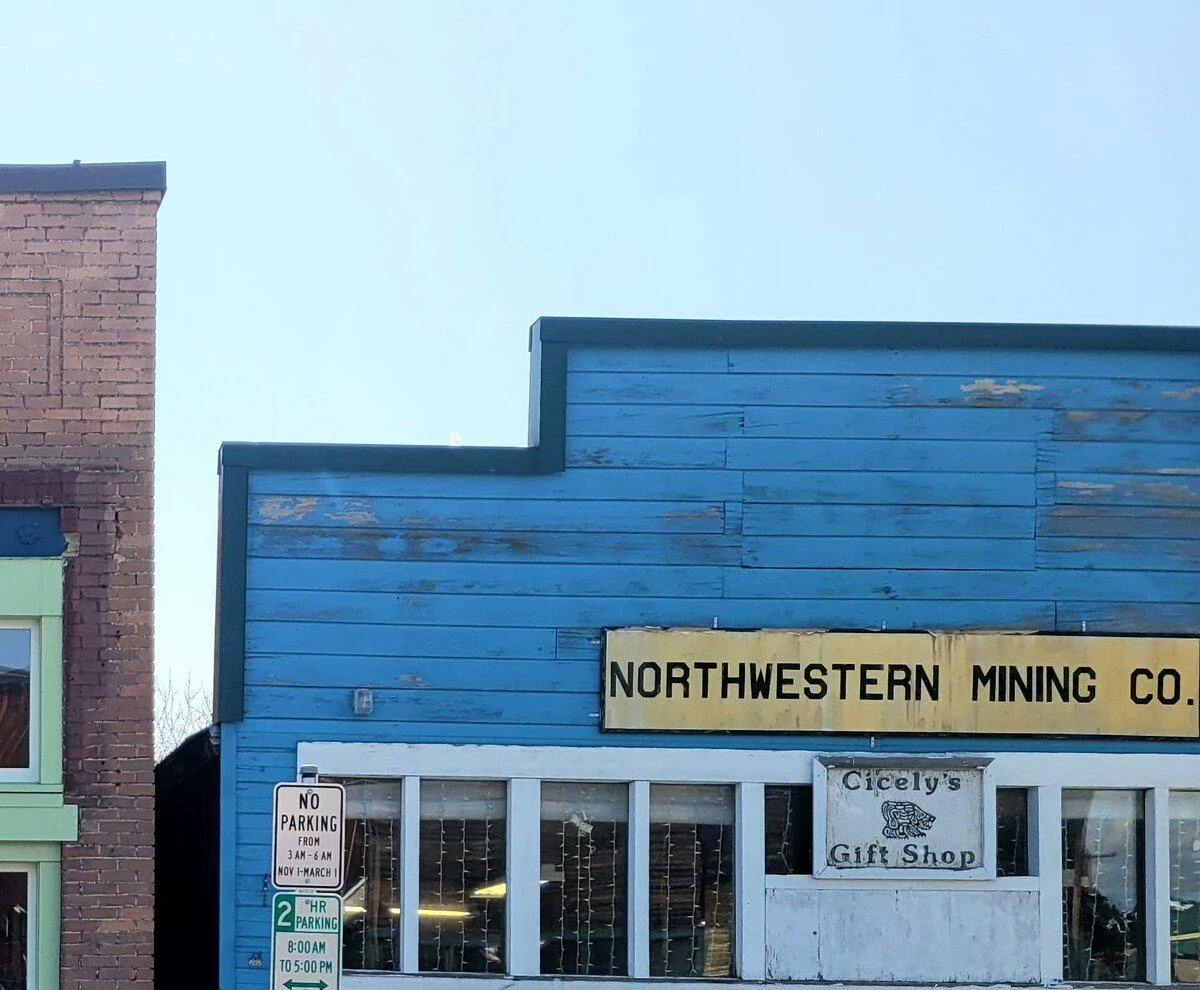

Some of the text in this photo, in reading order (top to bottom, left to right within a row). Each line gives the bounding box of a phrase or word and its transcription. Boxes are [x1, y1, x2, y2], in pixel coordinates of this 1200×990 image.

[609, 661, 1194, 705] NORTHWESTERN MINING CO.
[841, 769, 962, 796] Cicely's
[299, 793, 320, 810] NO
[280, 814, 338, 833] PARKING
[298, 836, 320, 847] FROM
[288, 850, 293, 860] 3
[295, 850, 306, 860] AM
[314, 851, 319, 861] 6
[321, 851, 332, 861] AM
[829, 842, 976, 870] Gift Shop
[278, 867, 294, 877] NOV
[334, 868, 338, 878] 1
[277, 900, 292, 927] 2
[310, 900, 327, 914] HR
[296, 916, 338, 931] PARKING
[280, 959, 333, 973] TO 5:00 PM
